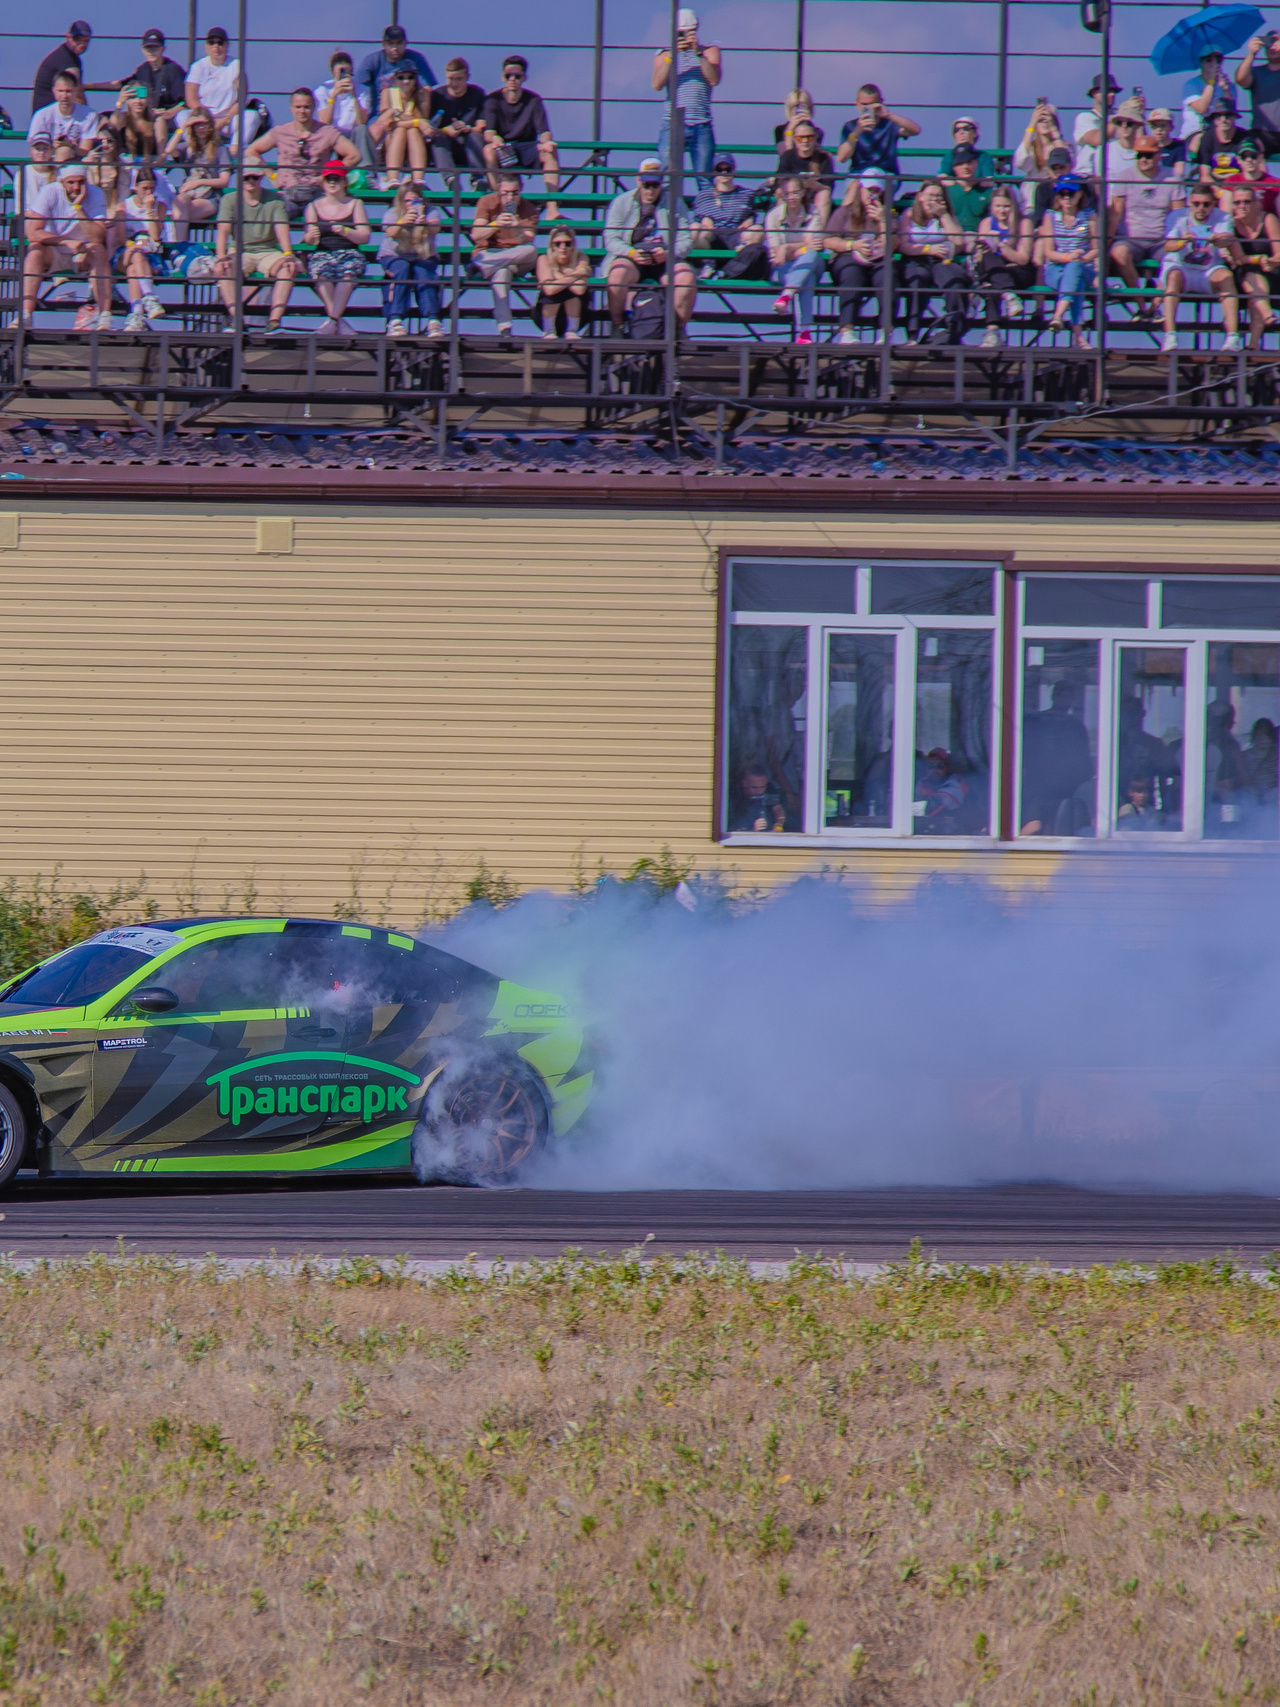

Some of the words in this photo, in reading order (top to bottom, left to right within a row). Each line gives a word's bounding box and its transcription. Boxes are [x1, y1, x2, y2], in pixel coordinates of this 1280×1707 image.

[103, 1037, 148, 1047] MAPETROL
[254, 1074, 273, 1082] СЕТЬ
[274, 1073, 317, 1081] ТРАССОВЫХ
[319, 1073, 369, 1081] КОМПЛЕКСОВ
[206, 1051, 420, 1126] Транспарк
